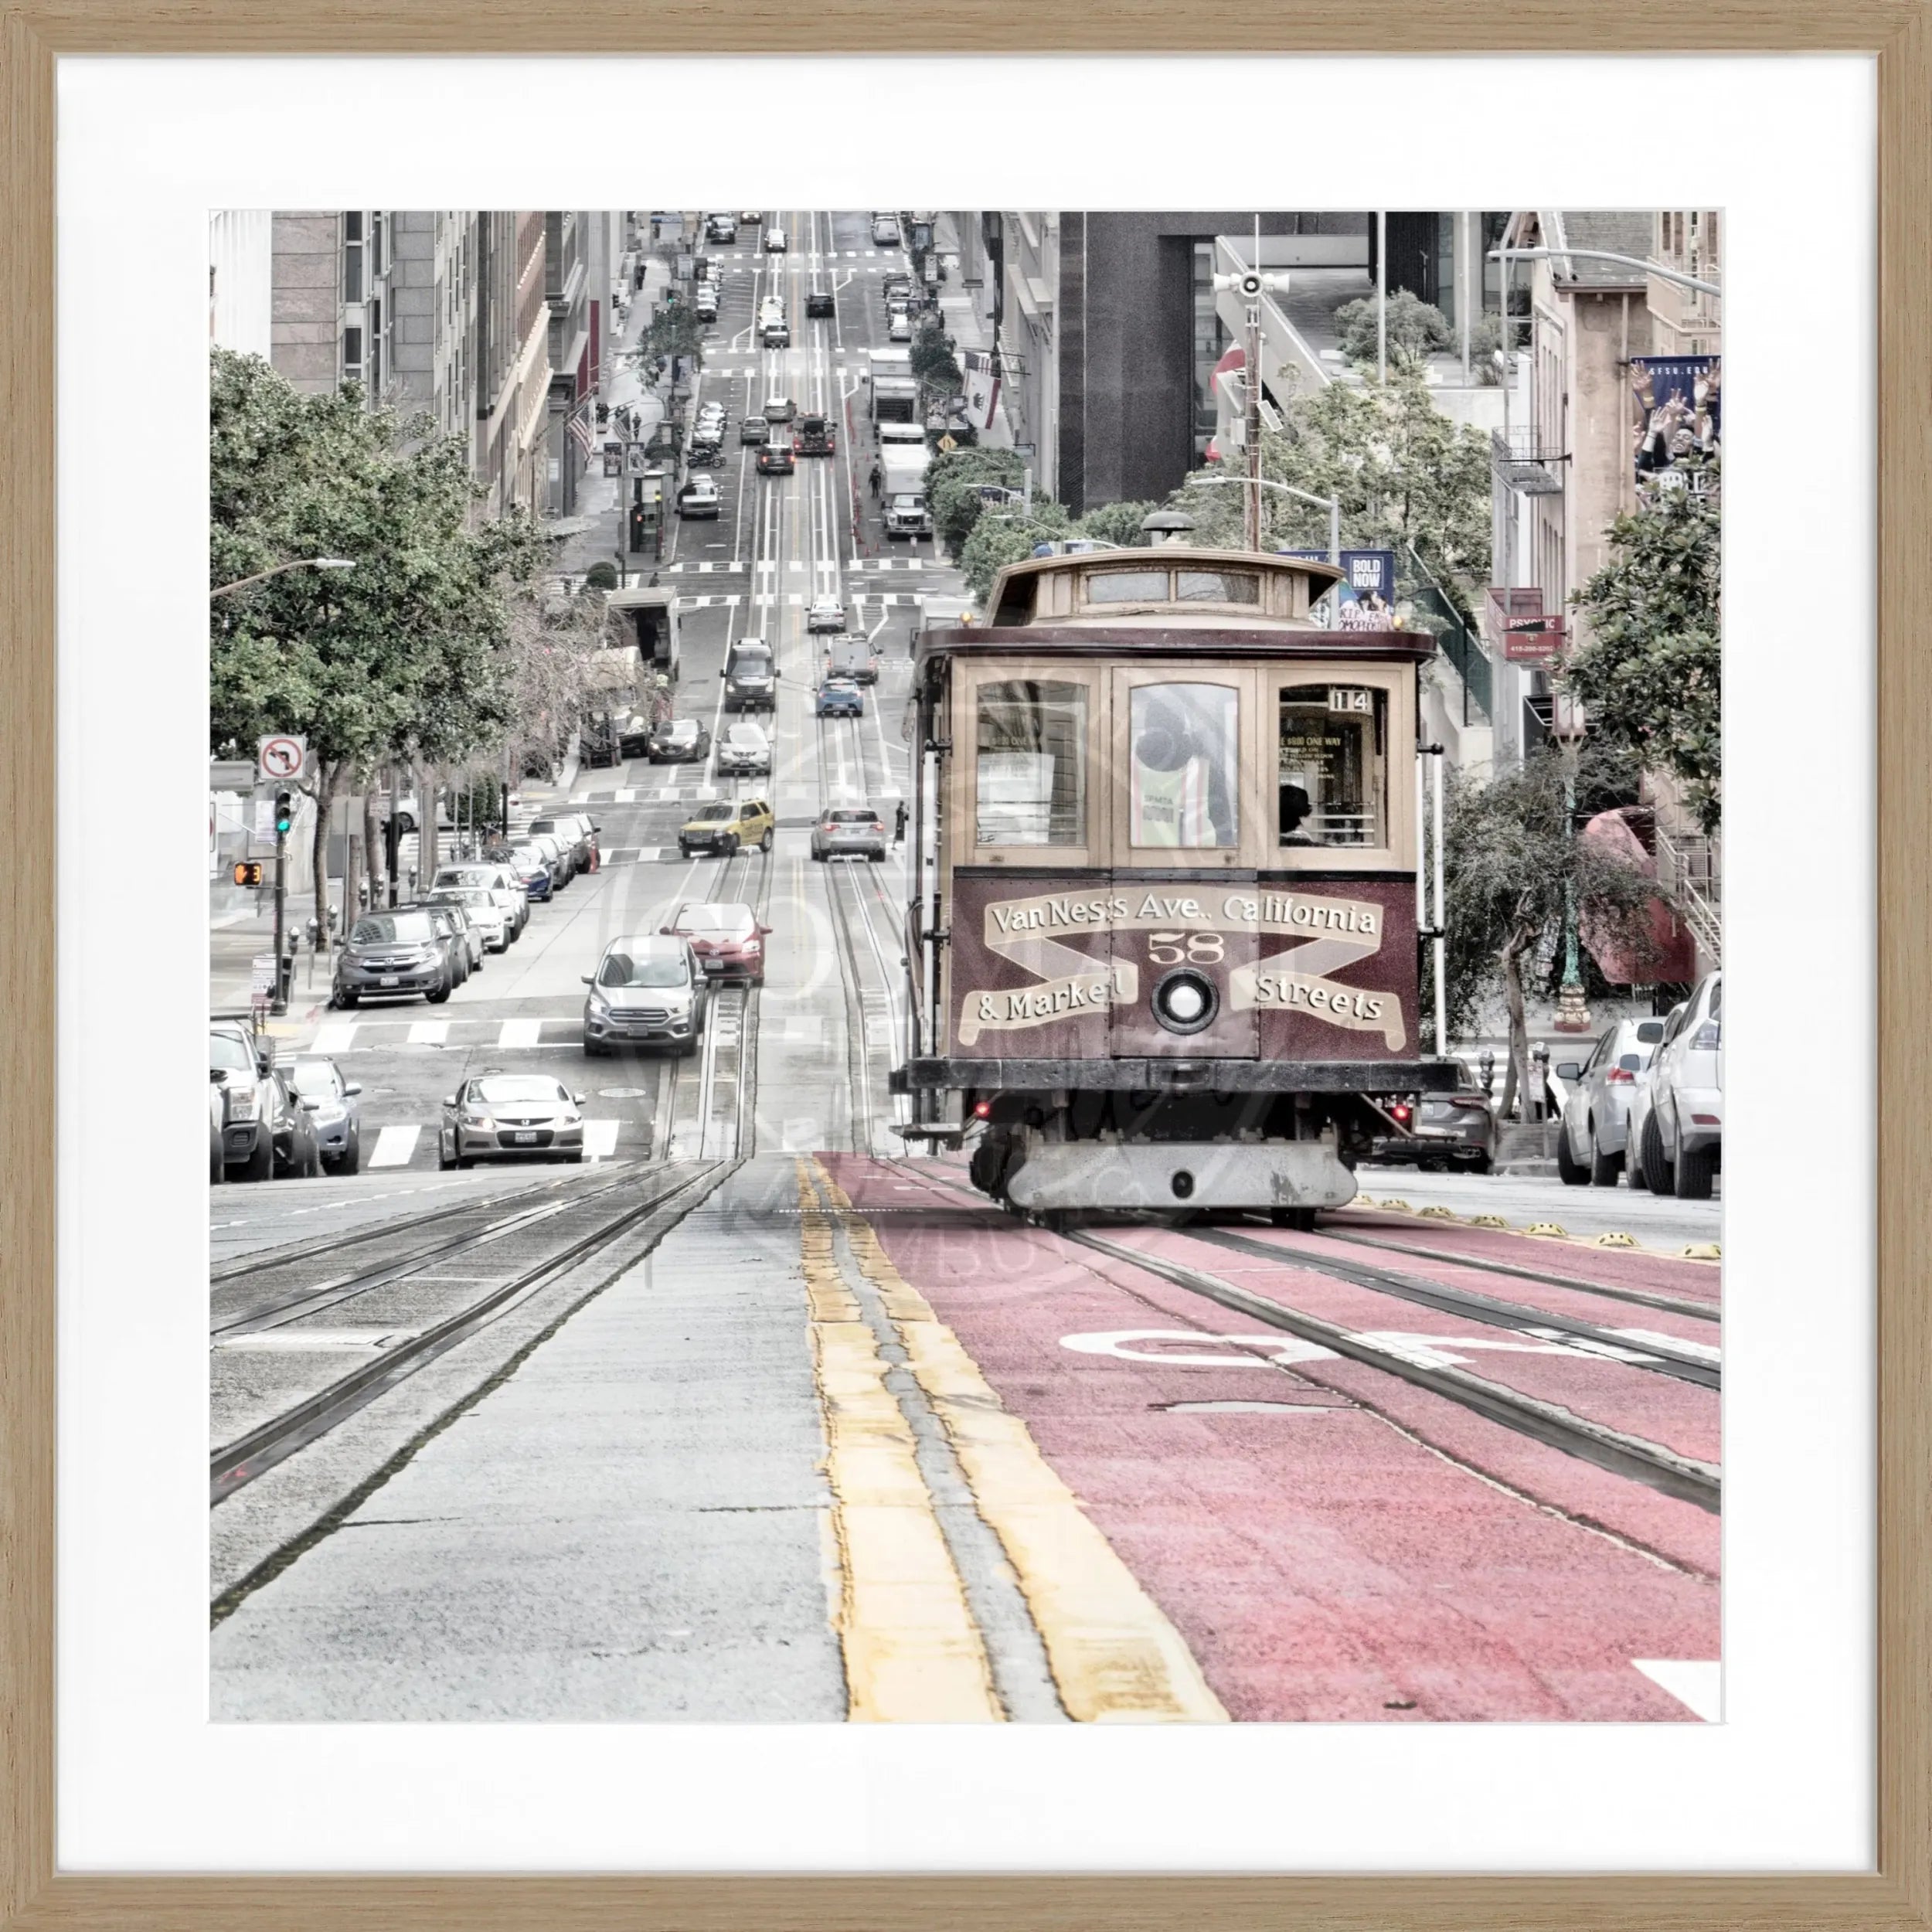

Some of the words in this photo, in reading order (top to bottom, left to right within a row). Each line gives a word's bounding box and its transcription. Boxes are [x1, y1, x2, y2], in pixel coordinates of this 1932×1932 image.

[1650, 366, 1709, 376] SFSU.EDU
[1352, 559, 1380, 573] BOLD
[1352, 573, 1380, 587] NOW
[1325, 736, 1342, 747] WAY
[992, 906, 1044, 933] Van
[1046, 897, 1128, 927] Ness
[1223, 894, 1377, 934] California
[1148, 933, 1225, 964] 58
[978, 994, 1002, 1021] &
[1254, 975, 1384, 1020] Streets
